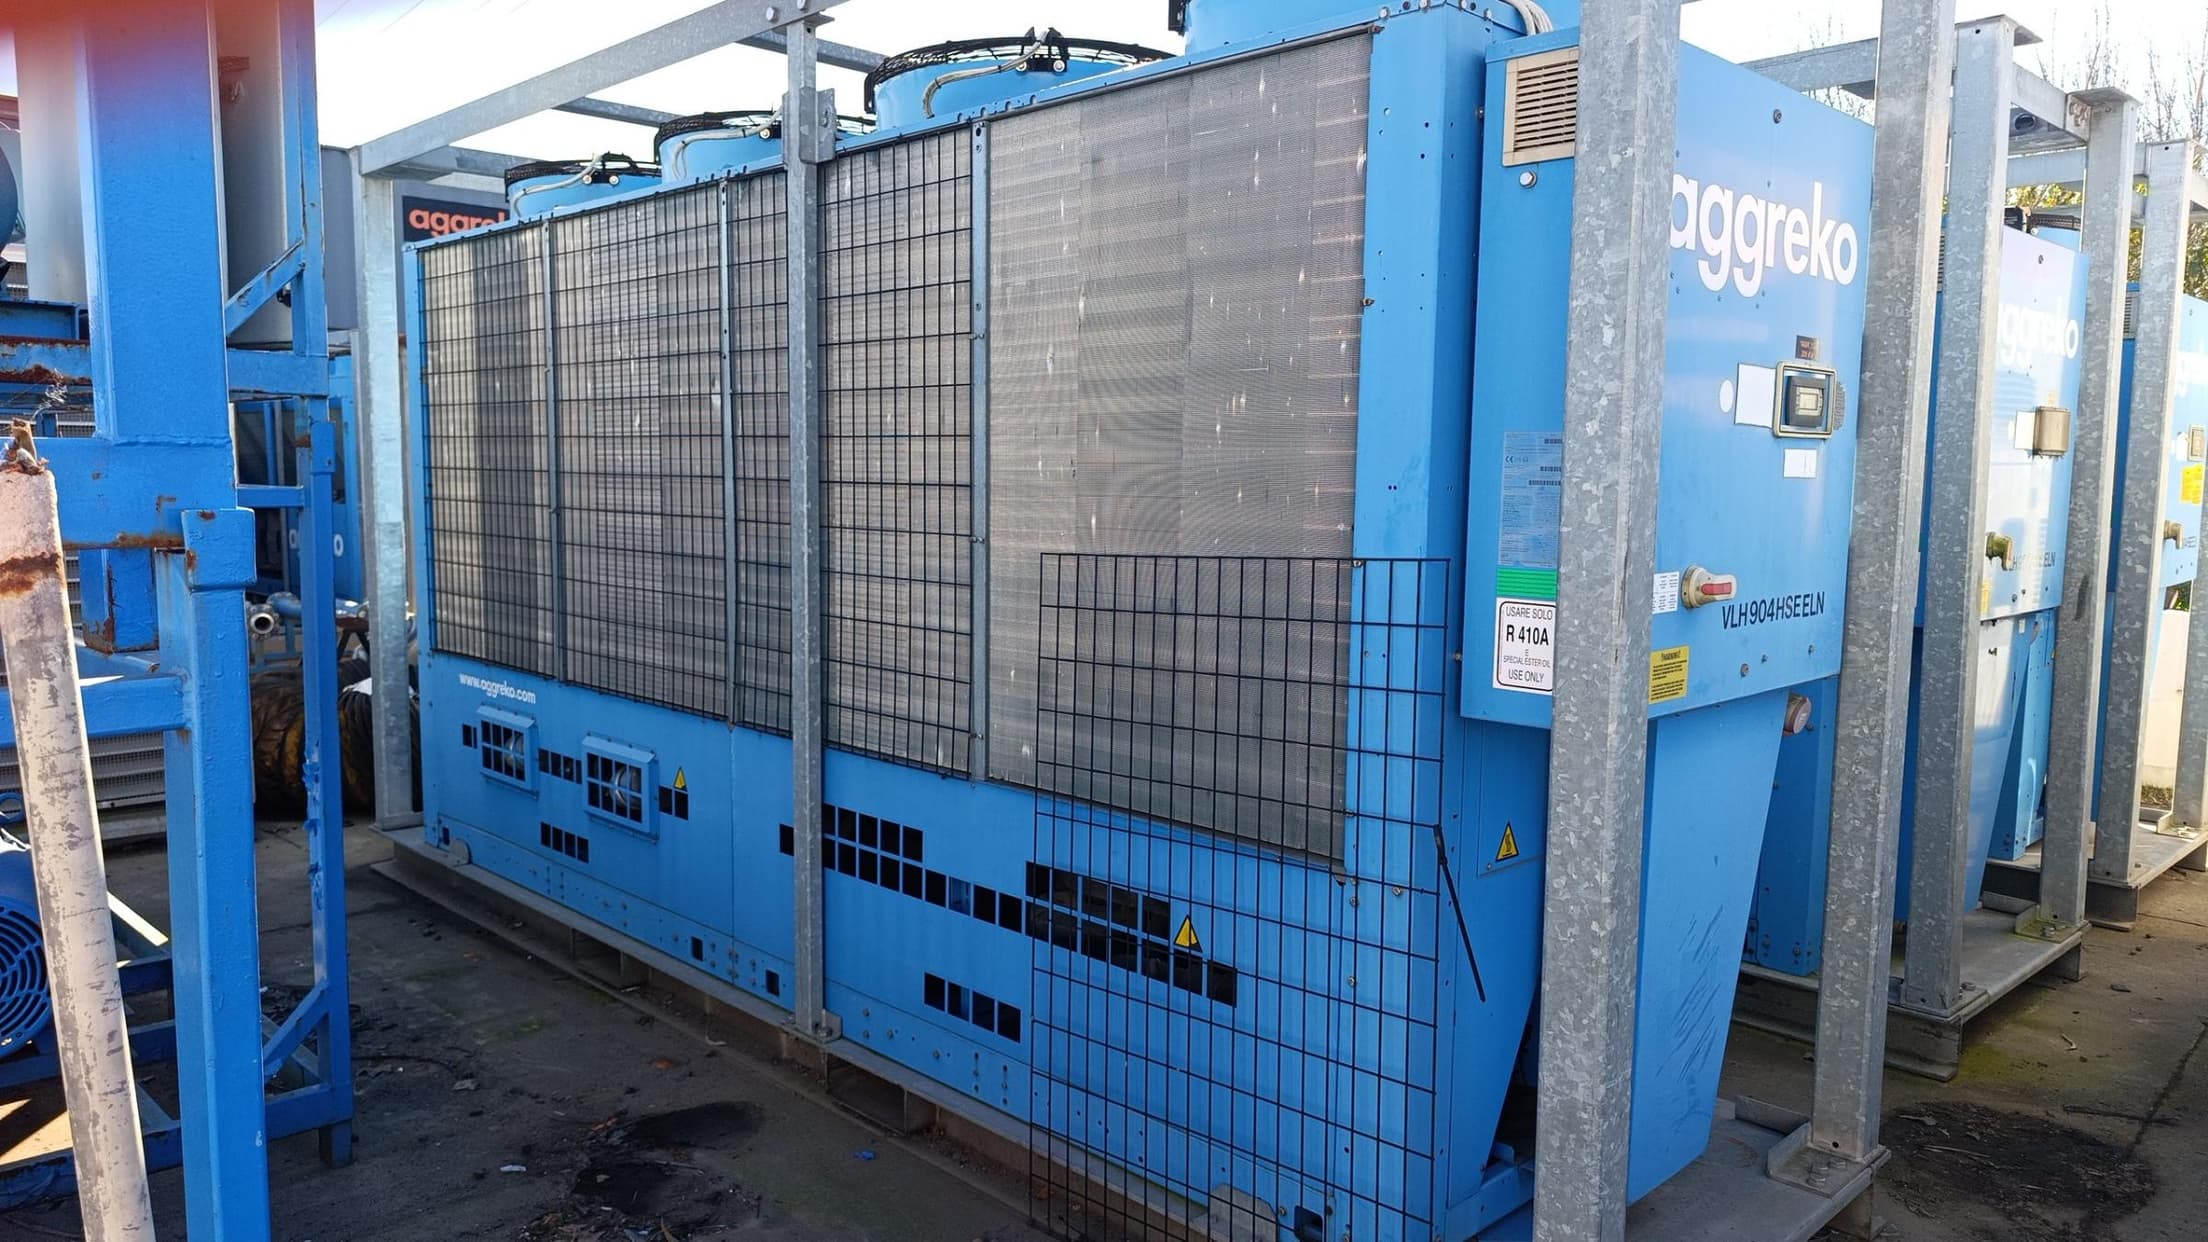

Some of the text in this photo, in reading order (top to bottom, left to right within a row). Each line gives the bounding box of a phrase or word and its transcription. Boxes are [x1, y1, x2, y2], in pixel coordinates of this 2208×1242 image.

[1670, 174, 1858, 298] aggreko
[1505, 606, 1553, 620] USARE SOLO
[1722, 591, 1825, 629] VLH904HSEELN
[1506, 624, 1549, 646] R 410A
[1503, 655, 1524, 665] SPECIAL
[1525, 657, 1541, 667] ESTER
[1508, 669, 1545, 683] USE ONLY
[459, 673, 537, 704] www.aggreko.com
